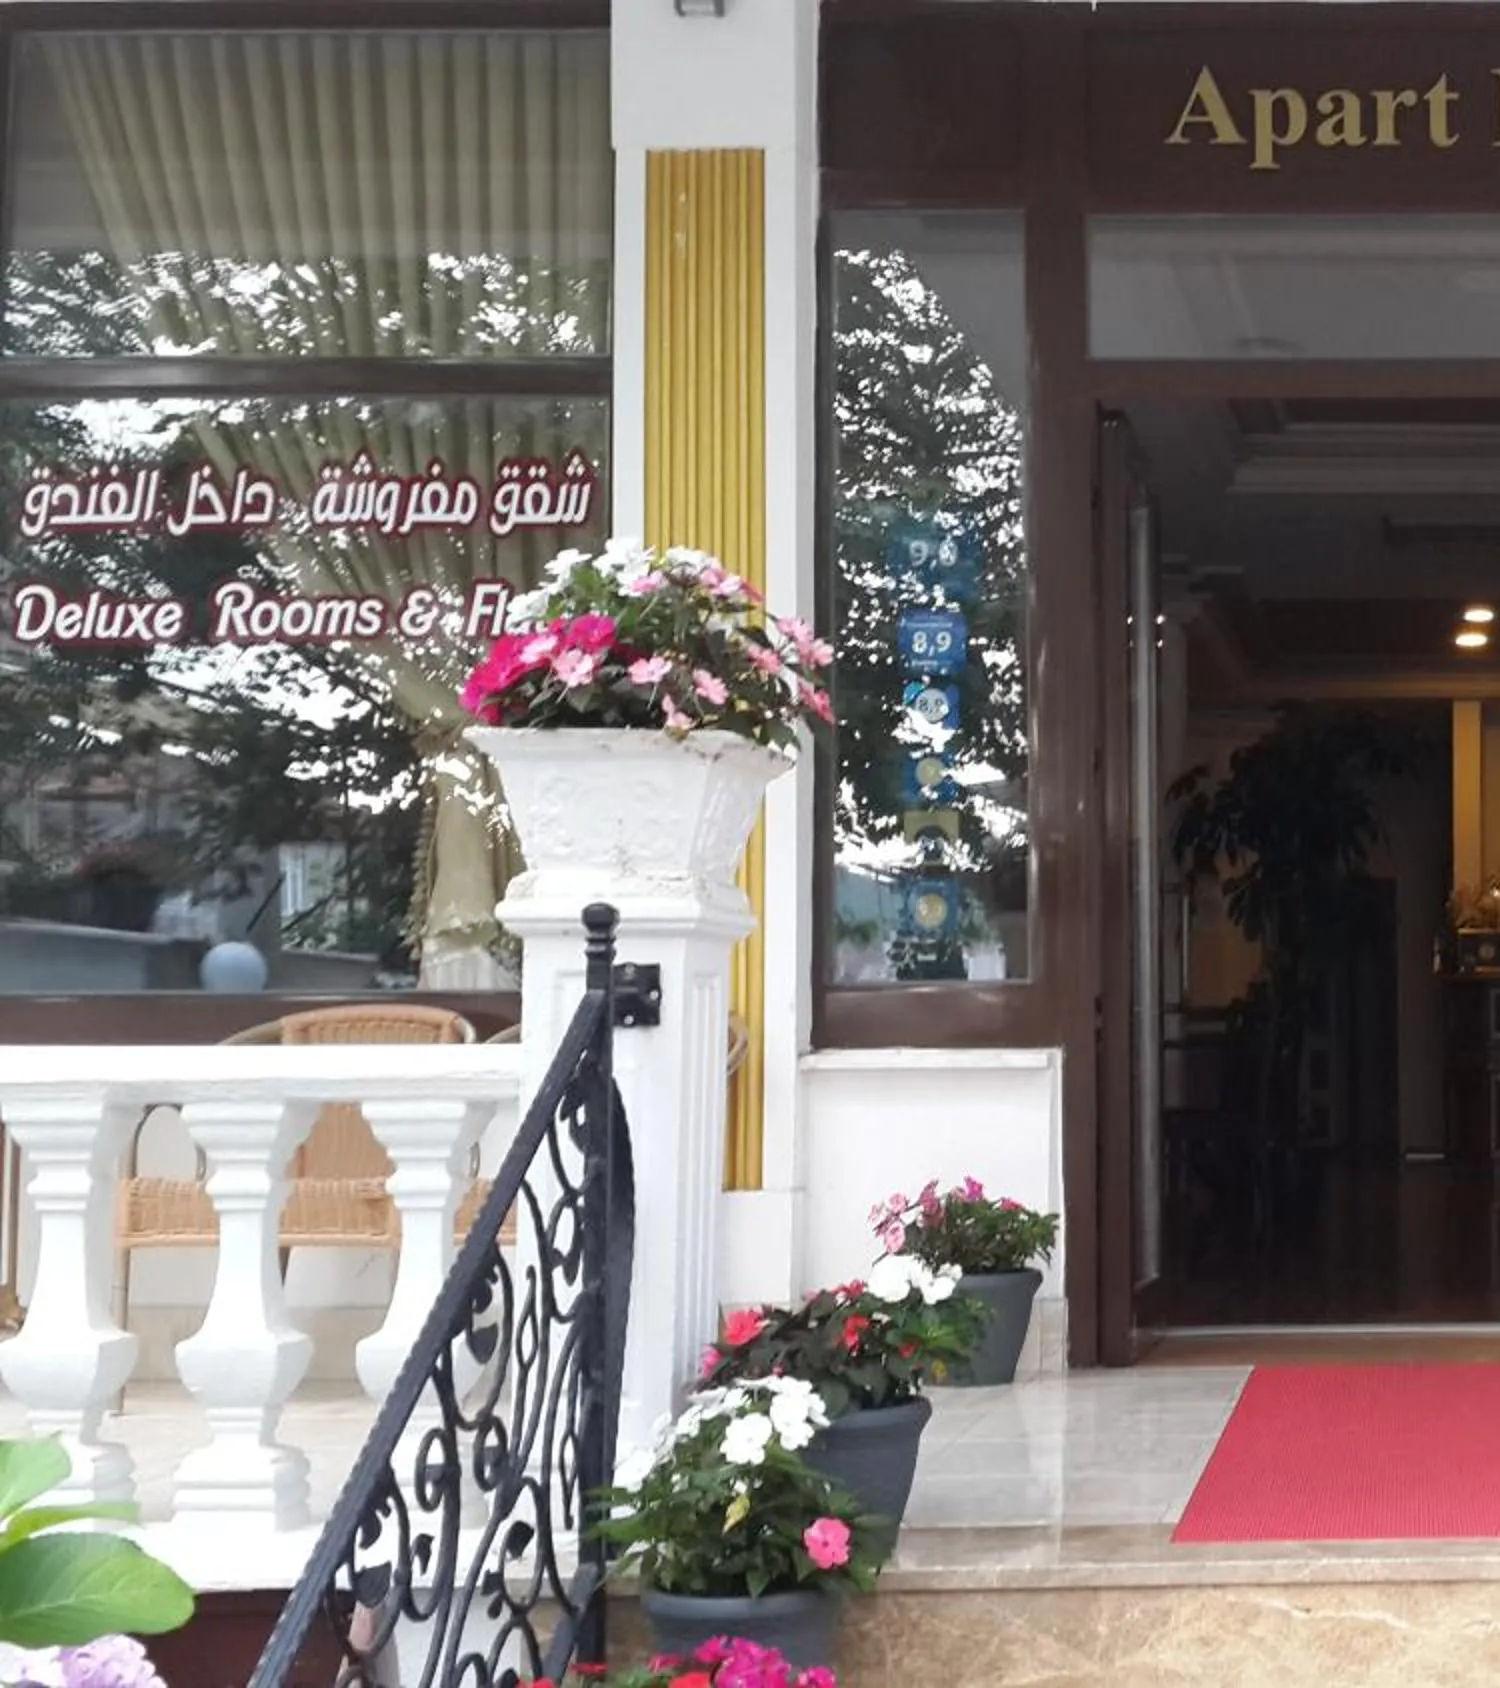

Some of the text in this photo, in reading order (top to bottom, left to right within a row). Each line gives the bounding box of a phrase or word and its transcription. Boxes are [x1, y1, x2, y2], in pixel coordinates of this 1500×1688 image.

[1163, 63, 1460, 169] Apart
[20, 453, 591, 537] شقق مفروشة داخل الفندق
[14, 584, 184, 641] Deluxe
[214, 581, 384, 638] Rooms
[400, 589, 439, 637] &
[911, 631, 952, 657] 8,9
